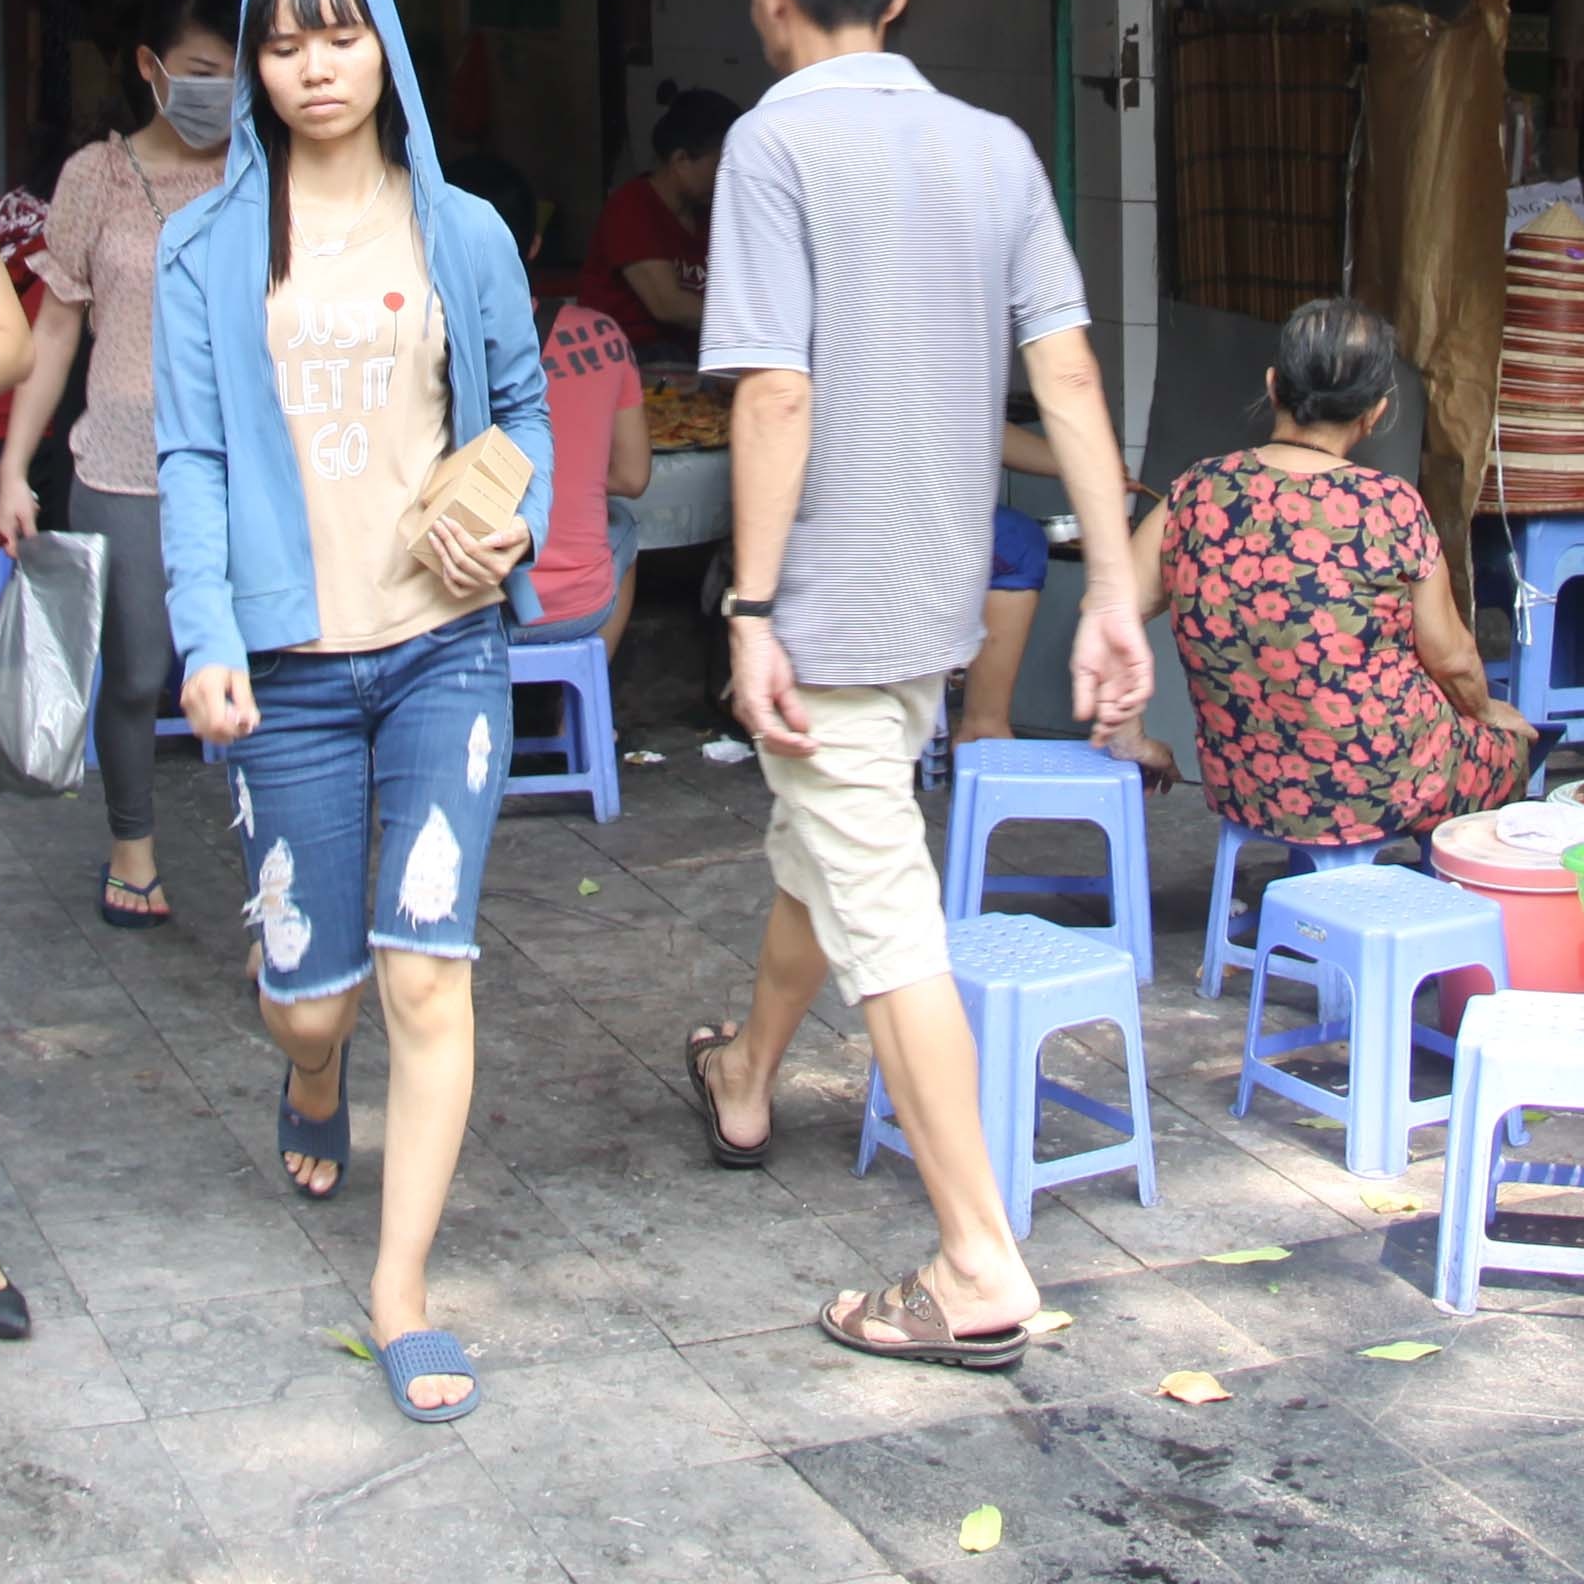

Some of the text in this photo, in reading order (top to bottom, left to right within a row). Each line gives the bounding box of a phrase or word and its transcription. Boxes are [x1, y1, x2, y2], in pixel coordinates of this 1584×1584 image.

[287, 296, 378, 350] JUST
[277, 354, 398, 416] LET IT
[309, 420, 370, 481] GO
